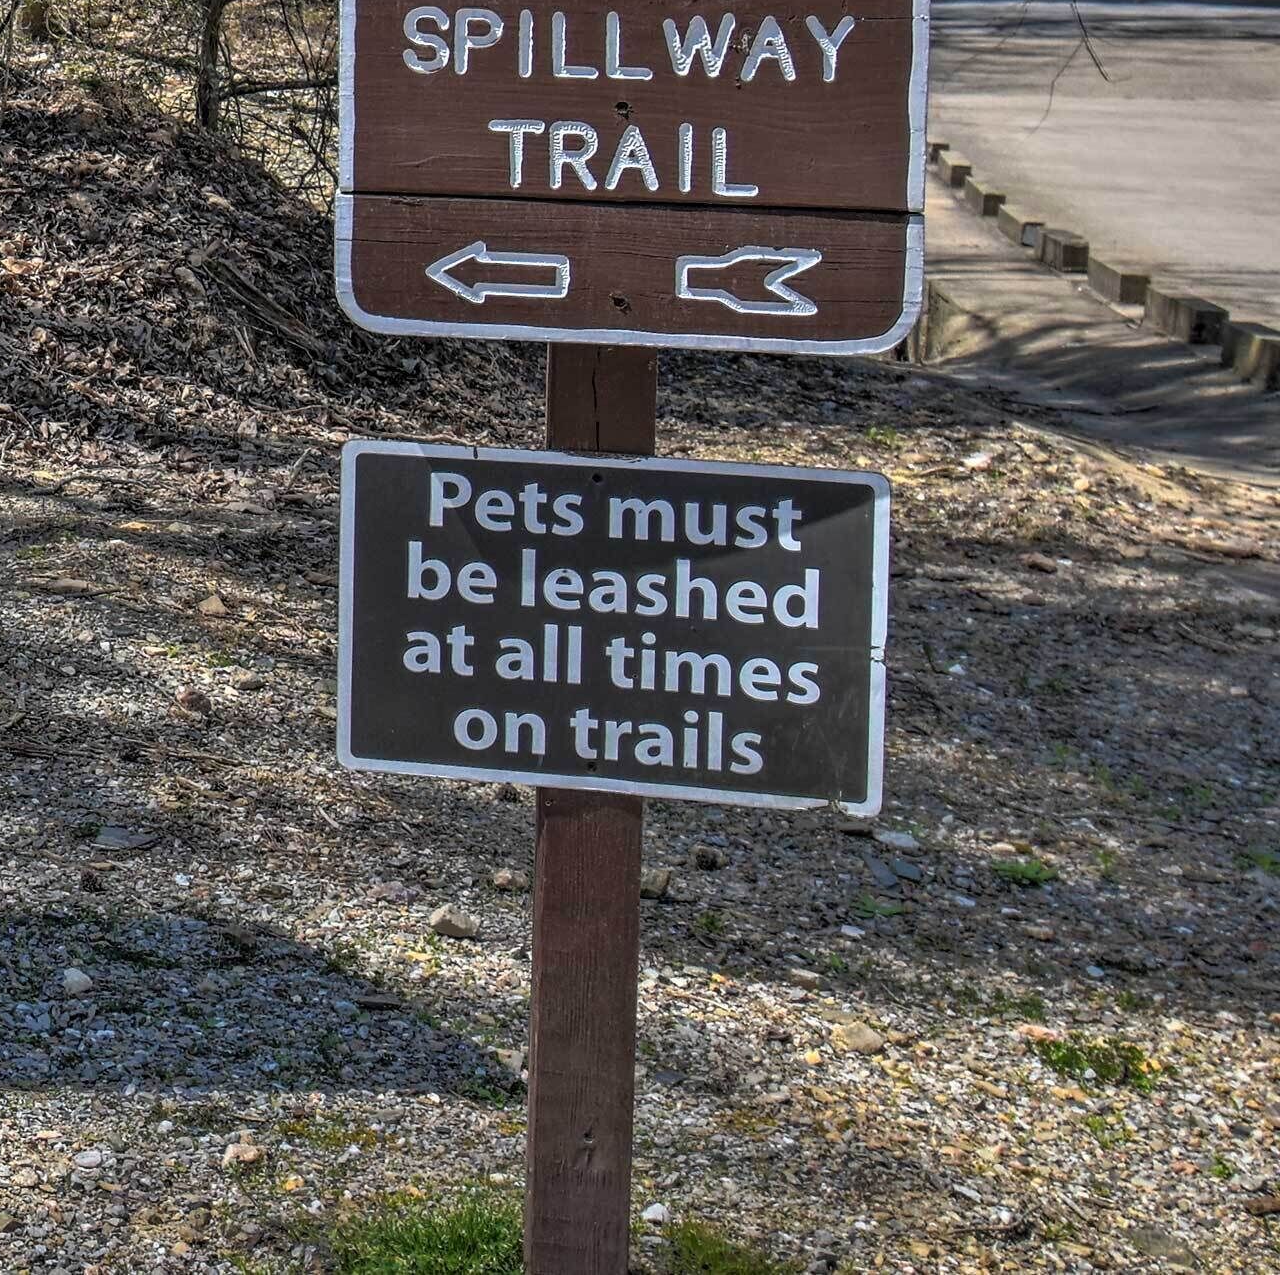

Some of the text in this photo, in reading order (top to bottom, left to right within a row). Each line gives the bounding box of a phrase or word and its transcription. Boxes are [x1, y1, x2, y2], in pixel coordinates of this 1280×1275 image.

[402, 5, 854, 84] SPILLWAY
[488, 118, 759, 198] TRAIL
[429, 472, 803, 553] Pets must
[406, 541, 822, 631] be leashed
[402, 622, 822, 706] at all times
[453, 707, 764, 776] on trails
